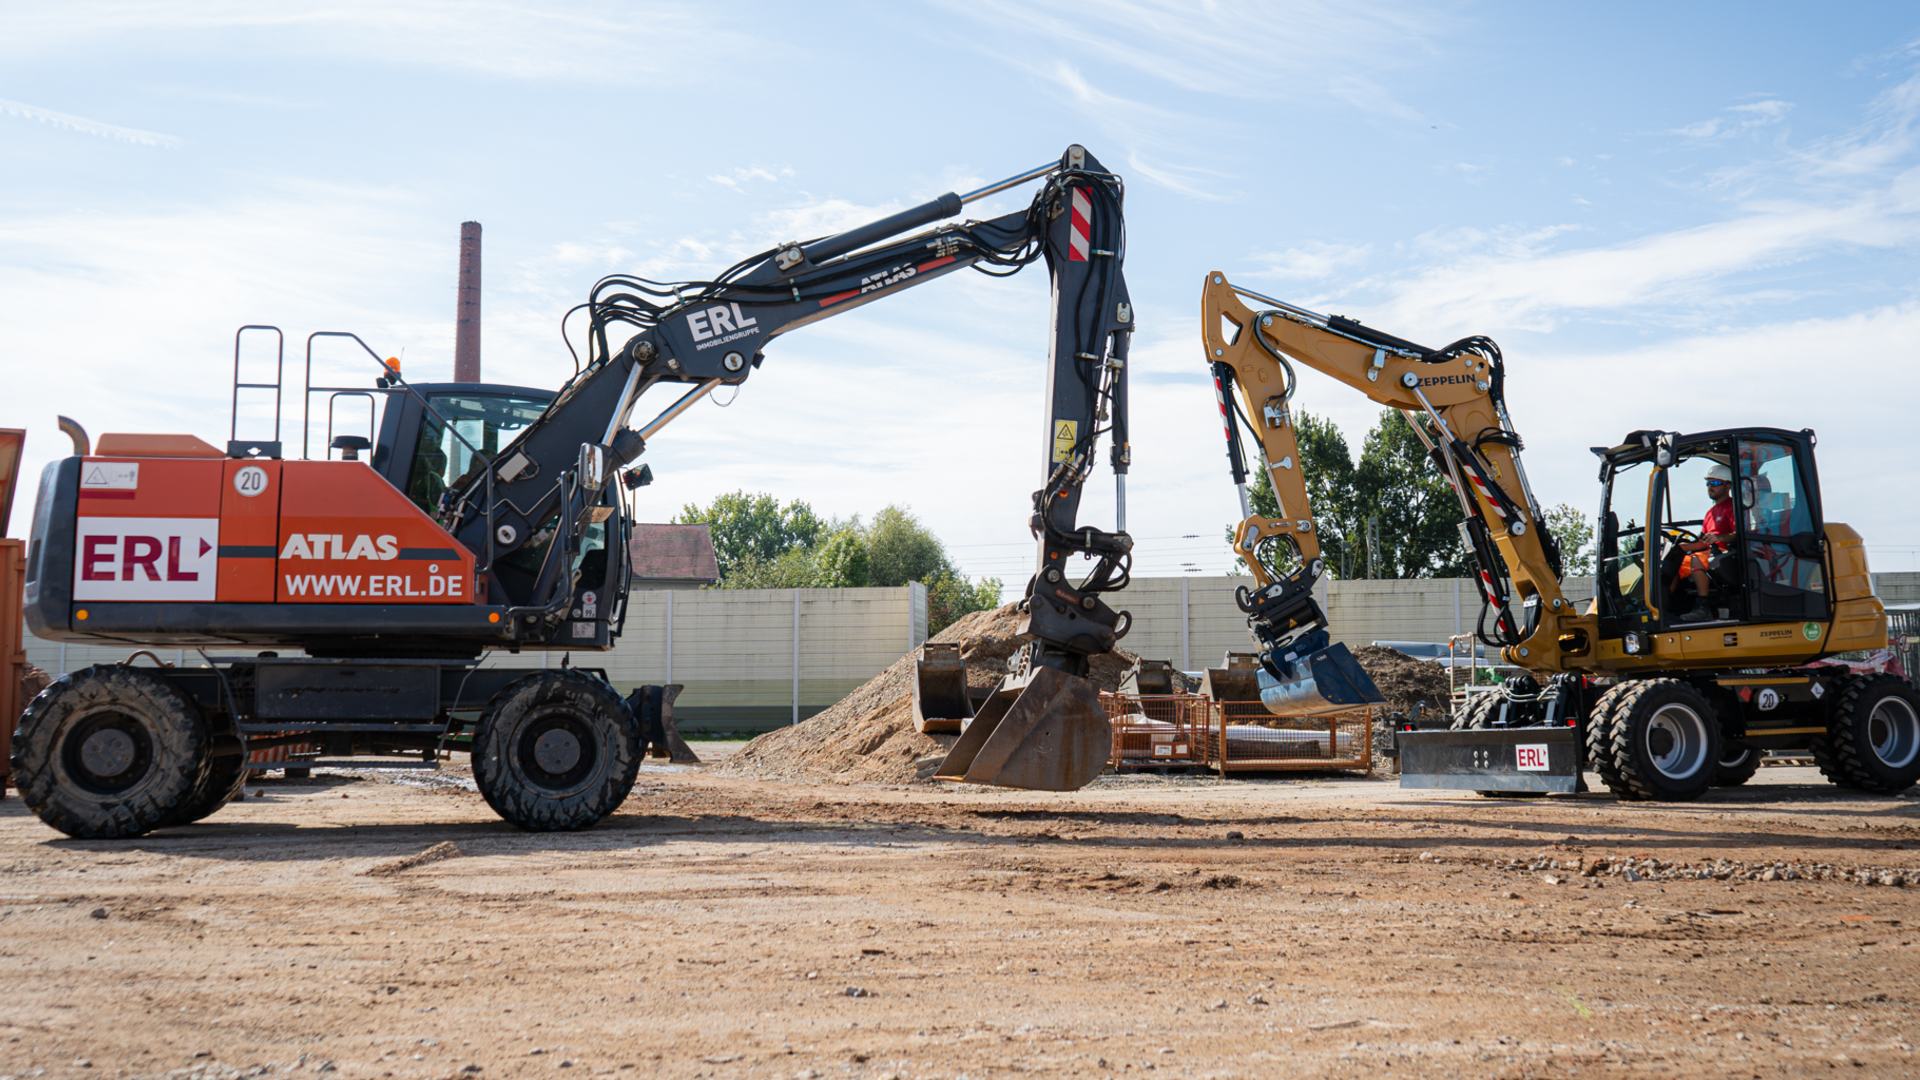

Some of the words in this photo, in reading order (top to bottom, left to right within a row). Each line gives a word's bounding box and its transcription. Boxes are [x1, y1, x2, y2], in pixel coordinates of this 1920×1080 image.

[861, 262, 917, 294] ATLAS
[686, 302, 757, 342] ERL
[695, 327, 760, 351] IMMOBILIENGRUPPE
[1417, 374, 1476, 387] ZEPPELIN
[241, 471, 261, 490] 20
[81, 535, 199, 581] ERL
[279, 533, 399, 561] ATLAS
[285, 574, 463, 597] WWW.ERL.DE
[1762, 694, 1774, 708] 20
[1518, 748, 1544, 766] ERL
